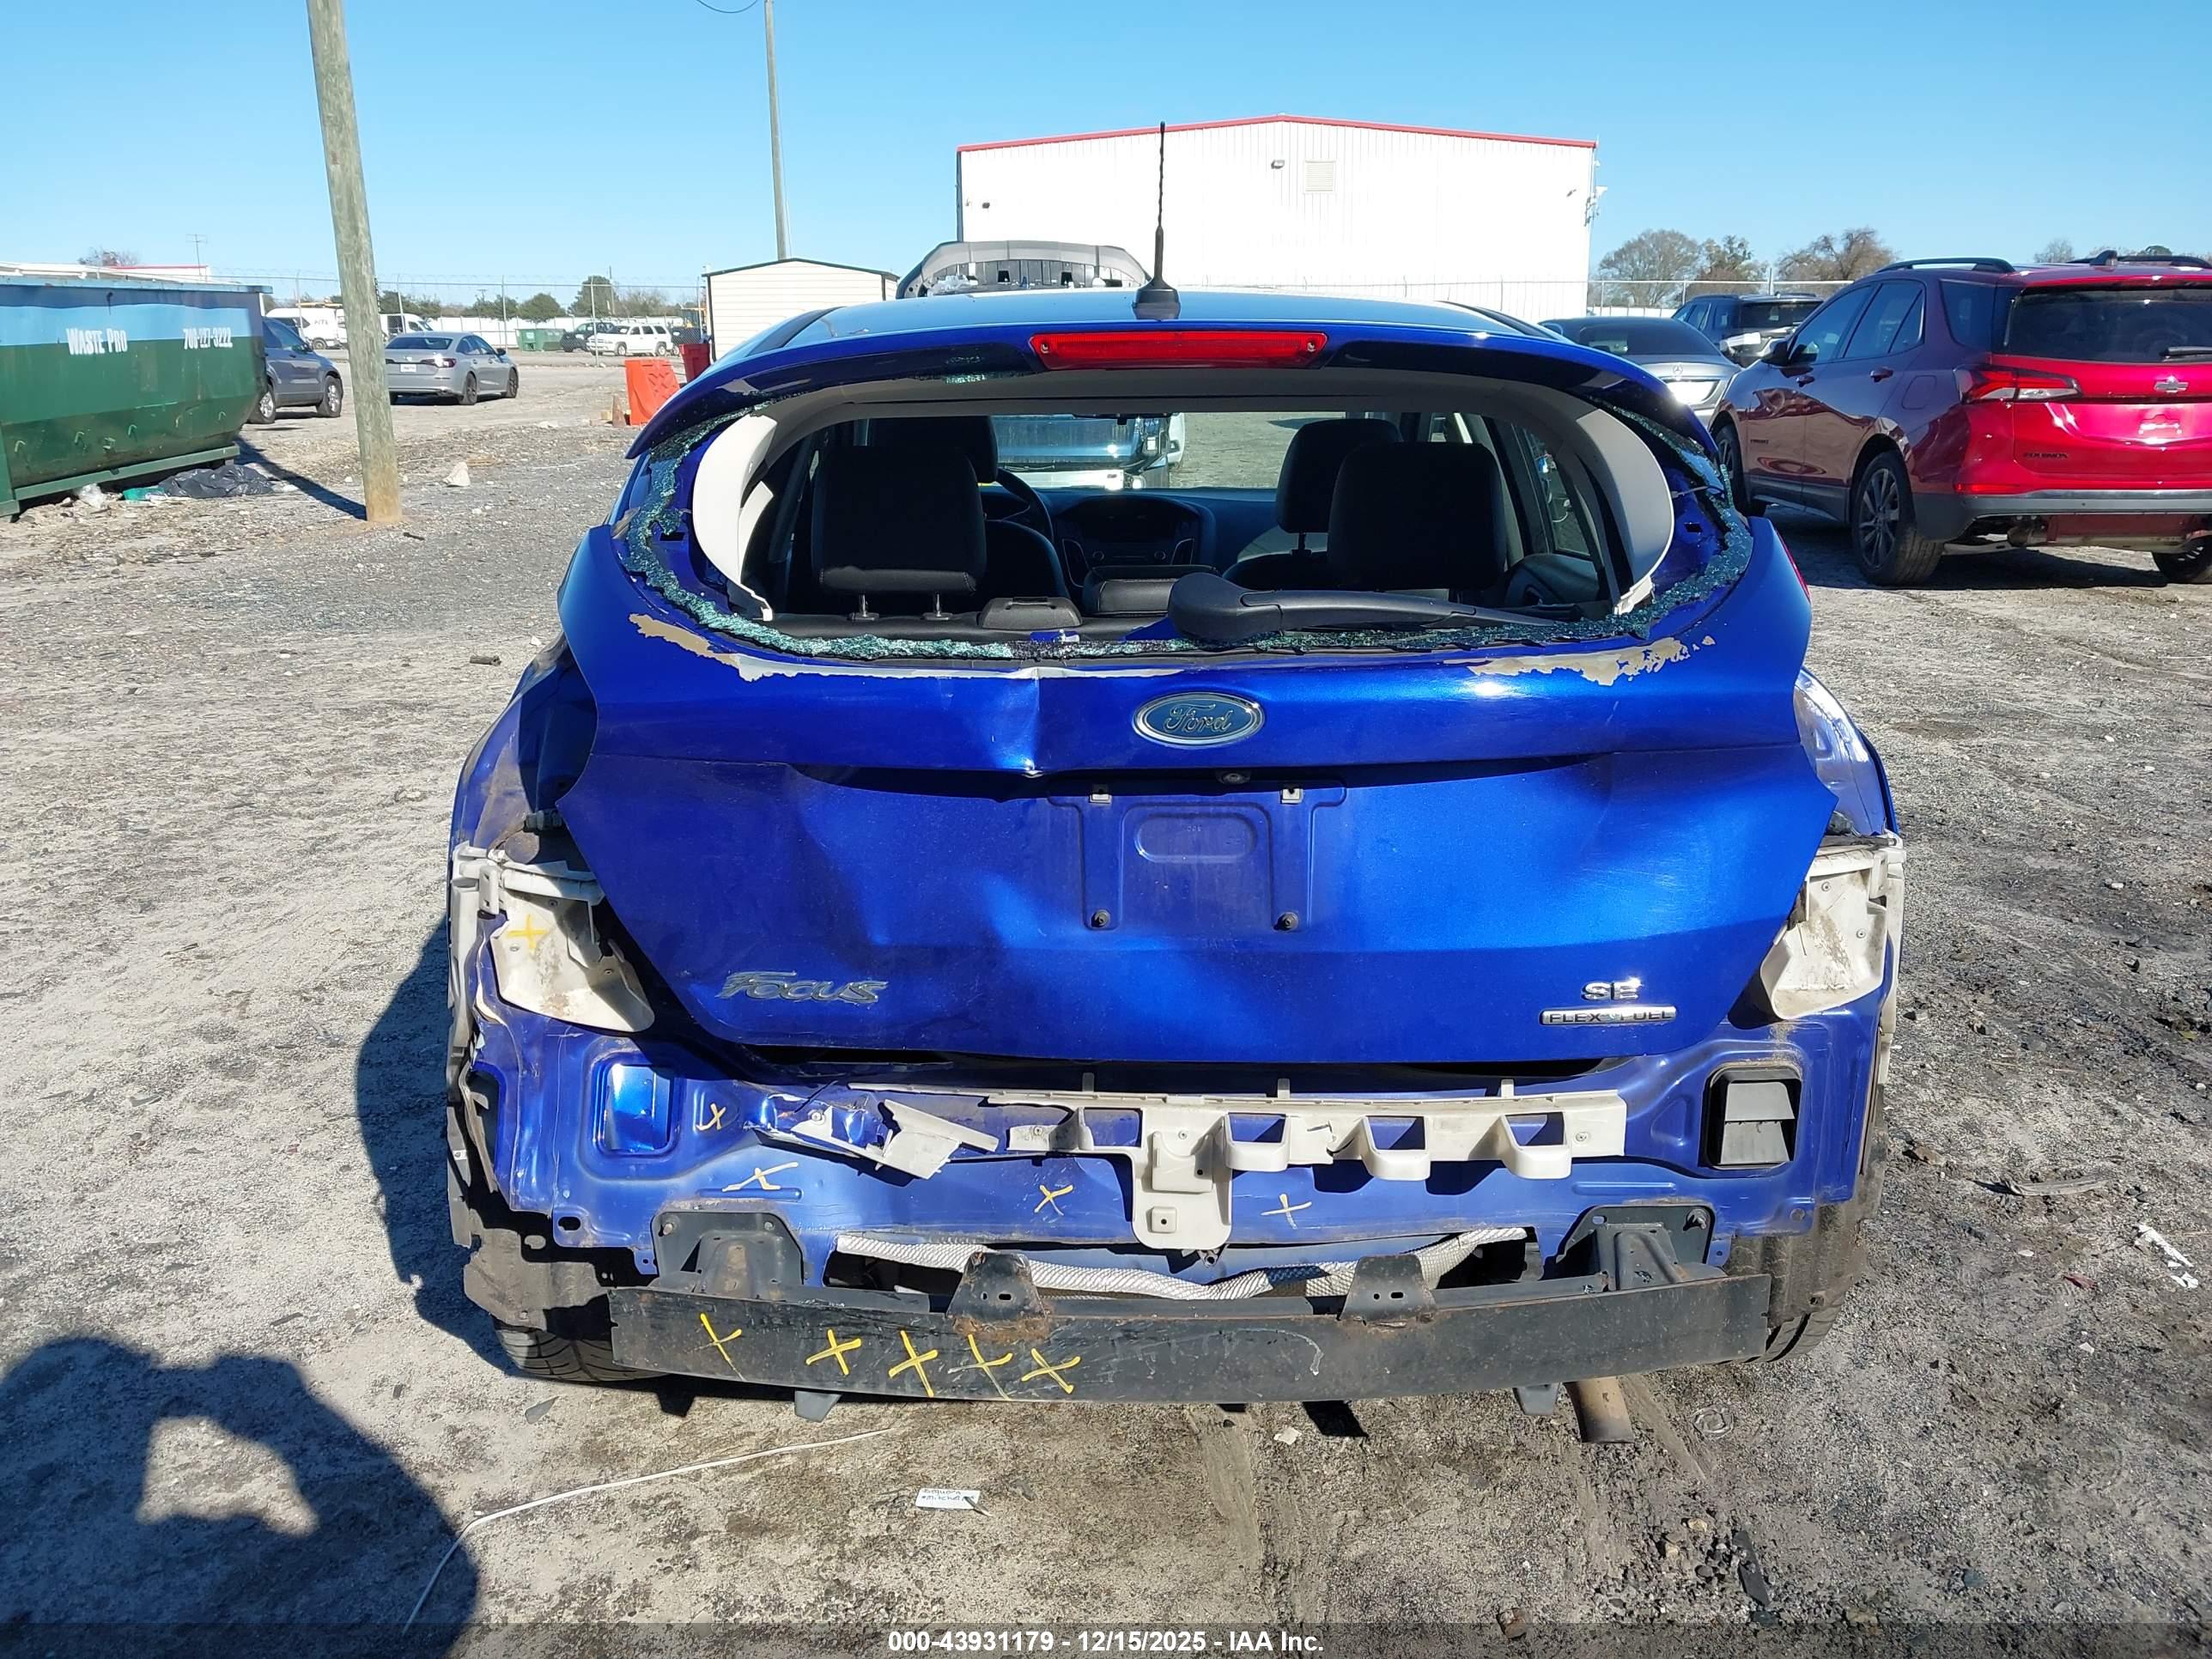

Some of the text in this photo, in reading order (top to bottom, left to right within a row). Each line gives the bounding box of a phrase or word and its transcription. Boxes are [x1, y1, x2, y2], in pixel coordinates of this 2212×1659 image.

[1164, 703, 1233, 732] Ford
[1581, 977, 1641, 1001] SE
[1549, 1013, 1601, 1024] FLEX
